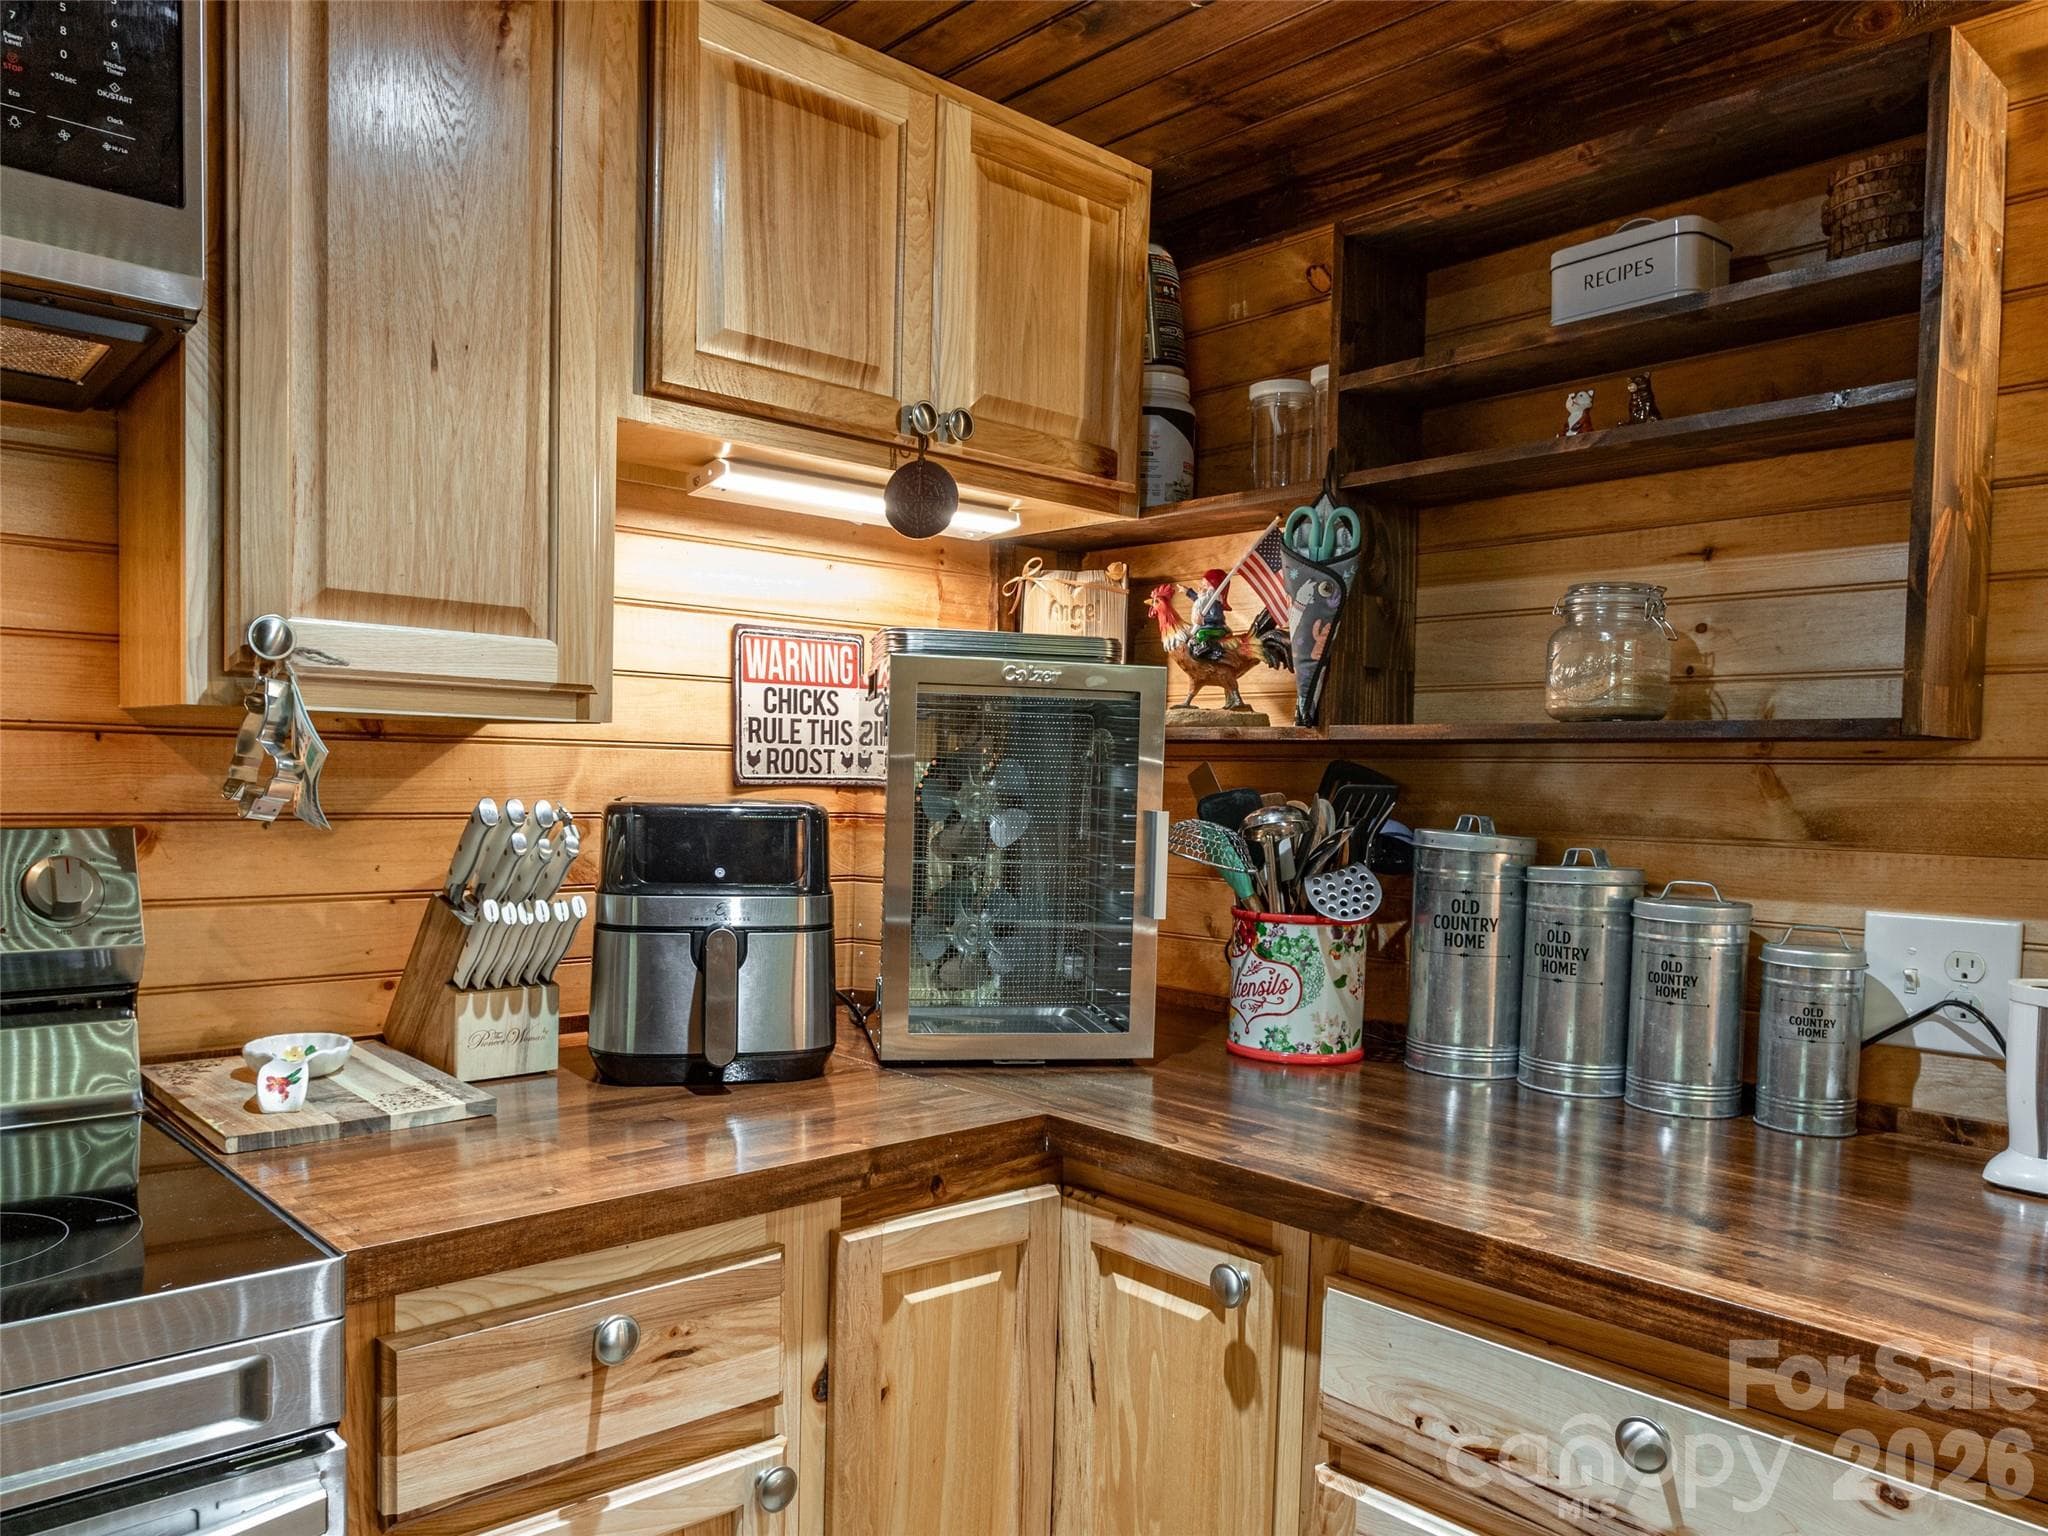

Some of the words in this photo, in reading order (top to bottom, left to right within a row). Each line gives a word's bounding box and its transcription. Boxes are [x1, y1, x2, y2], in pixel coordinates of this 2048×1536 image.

[9, 9, 16, 19] 7
[60, 2, 67, 12] 5
[111, 19, 118, 28] 6
[60, 26, 67, 36] 8
[111, 41, 118, 50] 9
[60, 49, 68, 59] 0
[2, 62, 23, 73] STOP
[103, 60, 127, 72] Kitchen
[106, 67, 124, 77] Timer
[8, 88, 21, 98] Eco
[97, 88, 133, 104] OK/START
[1584, 257, 1655, 291] RECIPES
[744, 638, 854, 685] WARNING
[763, 686, 839, 716] CHICKS
[748, 716, 802, 744] RULE
[807, 718, 853, 746] THIS
[766, 747, 836, 775] ROOST
[1450, 898, 1480, 915] OLD
[1433, 914, 1499, 933] COUNTRY
[1443, 932, 1486, 949] HOME
[1547, 929, 1571, 944] OLD
[1534, 943, 1590, 962] COUNTRY
[1541, 959, 1577, 976] HOME
[1661, 960, 1683, 973] OLD
[1648, 971, 1698, 987] COUNTRY
[1655, 985, 1687, 1000] HOME
[1803, 1007, 1824, 1018] OLD
[1789, 1015, 1837, 1029] COUNTRY
[1797, 1027, 1828, 1039] HOME
